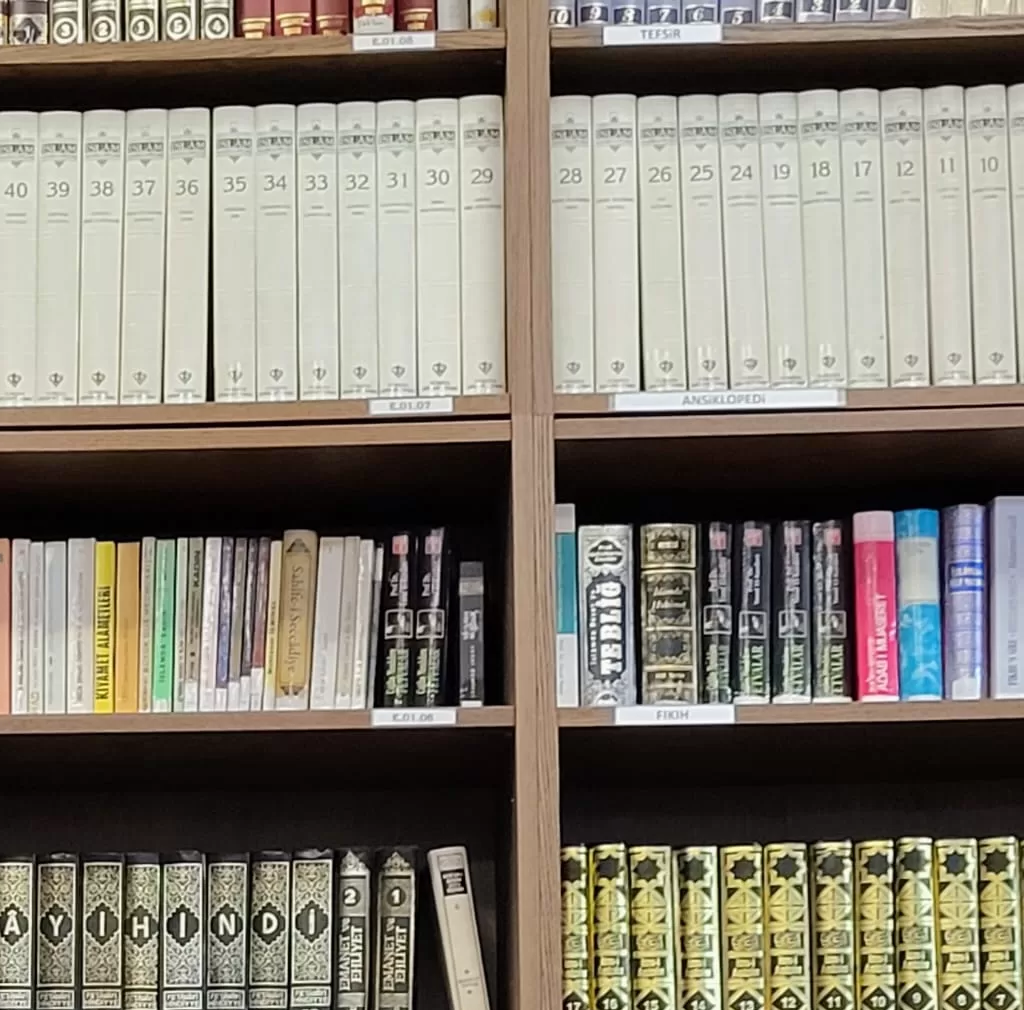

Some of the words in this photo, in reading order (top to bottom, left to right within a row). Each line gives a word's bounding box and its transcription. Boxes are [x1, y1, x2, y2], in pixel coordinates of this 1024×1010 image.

[550, 8, 568, 24] 10
[589, 4, 601, 20] 9
[659, 8, 672, 22] 7
[692, 7, 705, 22] 6
[732, 9, 744, 24] 5
[61, 24, 70, 37] 3
[98, 23, 109, 36] 2
[173, 19, 183, 32] 5
[212, 17, 222, 32] 4
[640, 29, 681, 40] TEFSİR
[773, 164, 790, 180] 19
[812, 161, 830, 177] 18
[854, 160, 871, 176] 17
[896, 161, 914, 176] 12
[939, 157, 955, 174] 11
[981, 156, 998, 173] 10
[345, 172, 369, 190] 32
[386, 171, 409, 189] 31
[426, 169, 449, 187] 30
[470, 168, 493, 186] 29
[559, 168, 582, 184] 28
[604, 167, 626, 183] 27
[648, 167, 672, 183] 26
[690, 165, 713, 181] 25
[730, 165, 753, 181] 24
[4, 180, 28, 198] 40
[46, 180, 70, 198] 39
[90, 179, 114, 197] 38
[131, 179, 156, 196] 37
[175, 178, 199, 196] 36
[222, 175, 246, 193] 35
[263, 174, 287, 191] 34
[304, 173, 328, 191] 33
[682, 393, 766, 406] ANSİKLOPEDİ
[97, 585, 112, 648] ALAMETLERİ
[594, 581, 622, 675] TEBLİĞ
[96, 651, 110, 701] KIYAMET
[656, 711, 689, 720] FIKIH
[343, 889, 357, 904] 2
[391, 889, 401, 904] 1
[48, 914, 64, 937] Y
[132, 915, 150, 939] H
[218, 912, 234, 936] N
[262, 911, 278, 935] D
[350, 926, 364, 983] EHLİYET
[395, 926, 407, 983] EHLİYET
[339, 935, 351, 991] EMANET
[382, 935, 394, 991] EMANET
[602, 997, 618, 1010] 16
[781, 997, 797, 1009] 12
[827, 996, 841, 1008] 11
[870, 995, 887, 1008] 10
[912, 991, 921, 1004] 9
[957, 994, 967, 1006] 8
[996, 994, 1006, 1007] 7
